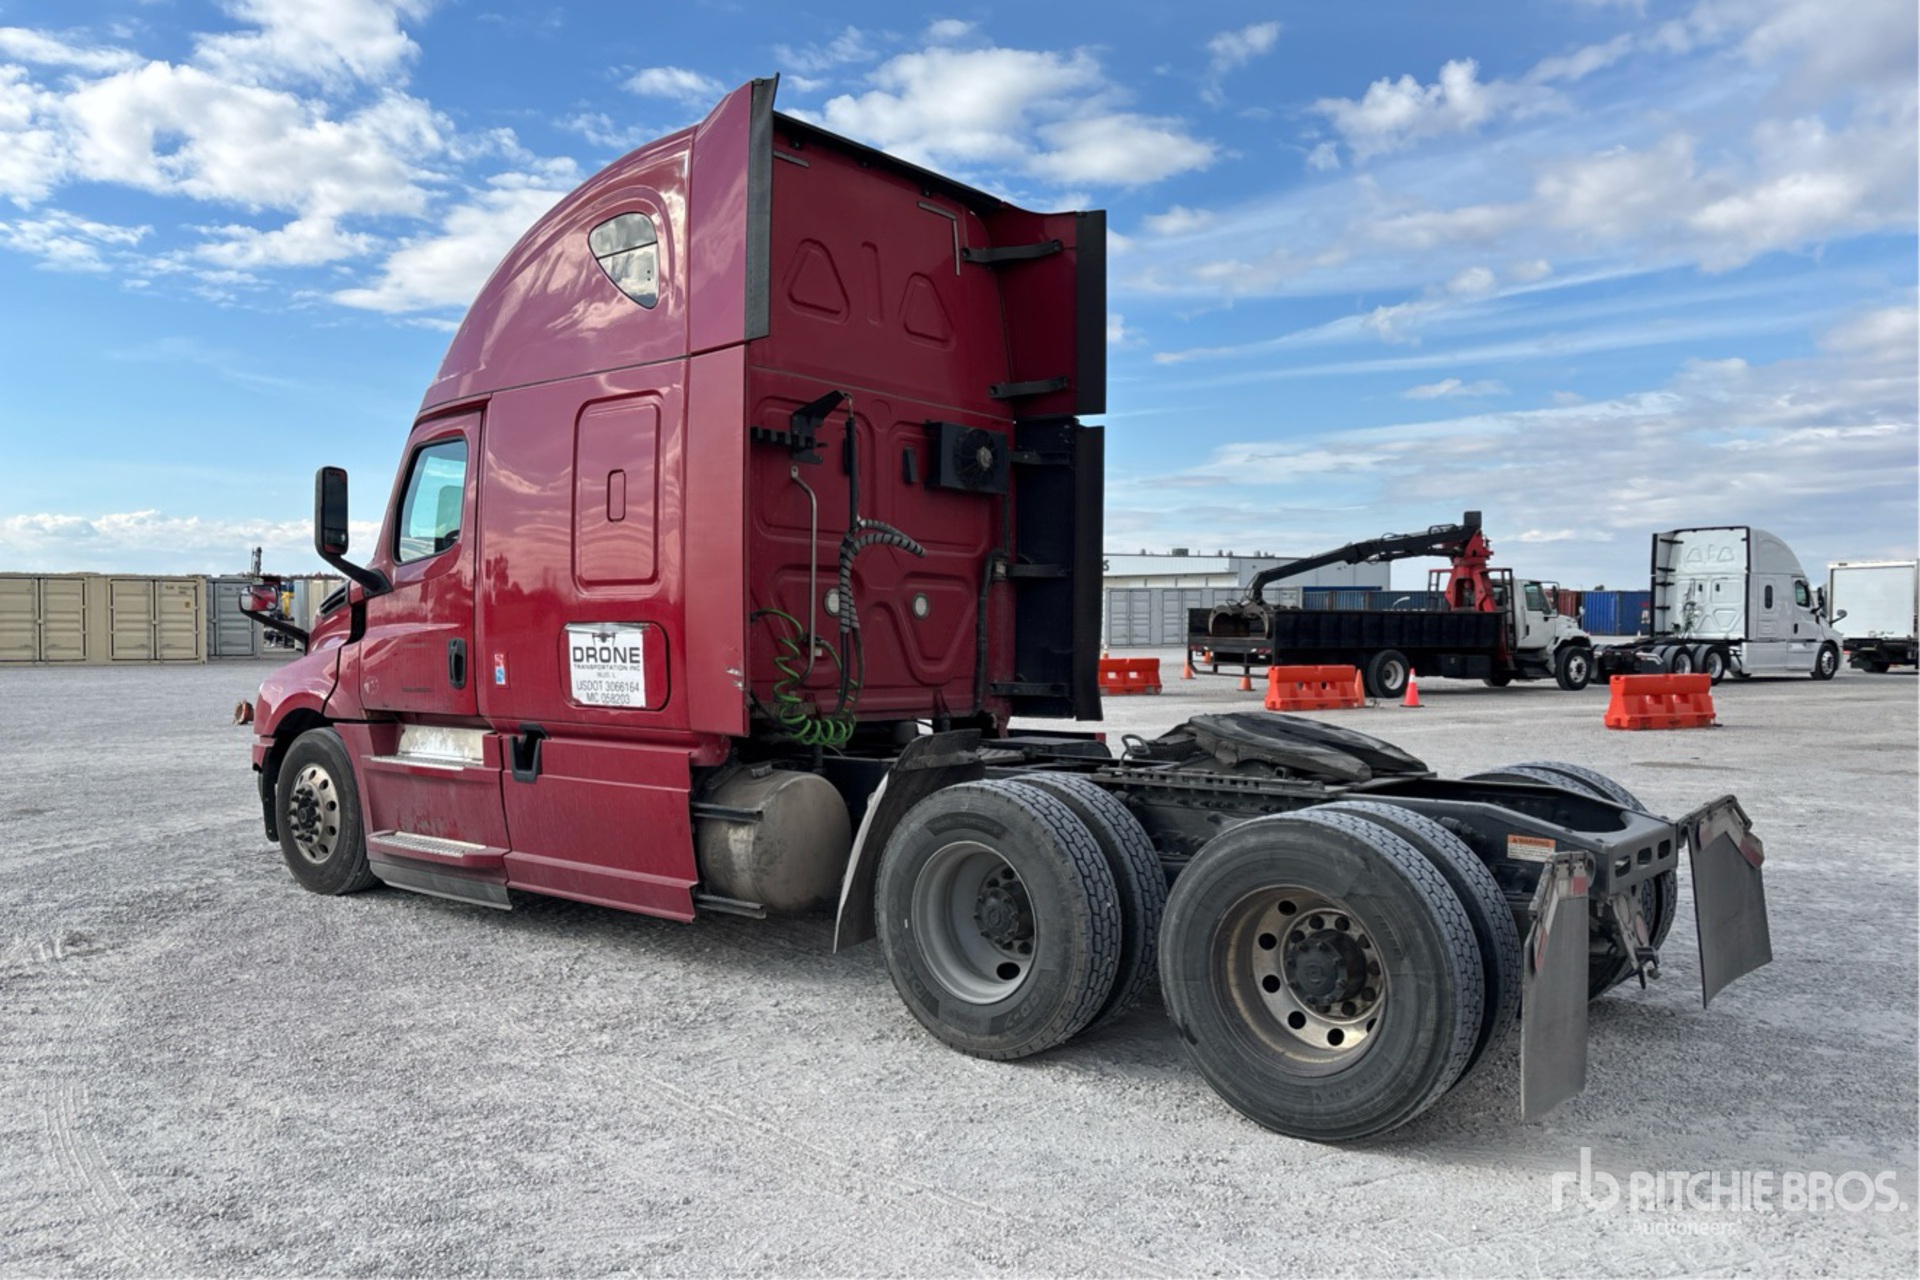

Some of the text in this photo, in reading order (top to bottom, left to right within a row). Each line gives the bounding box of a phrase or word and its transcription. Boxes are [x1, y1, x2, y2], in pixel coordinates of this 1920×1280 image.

[573, 647, 640, 663] DRONE
[576, 680, 639, 692] USDOT 3066164
[586, 692, 600, 703] MC
